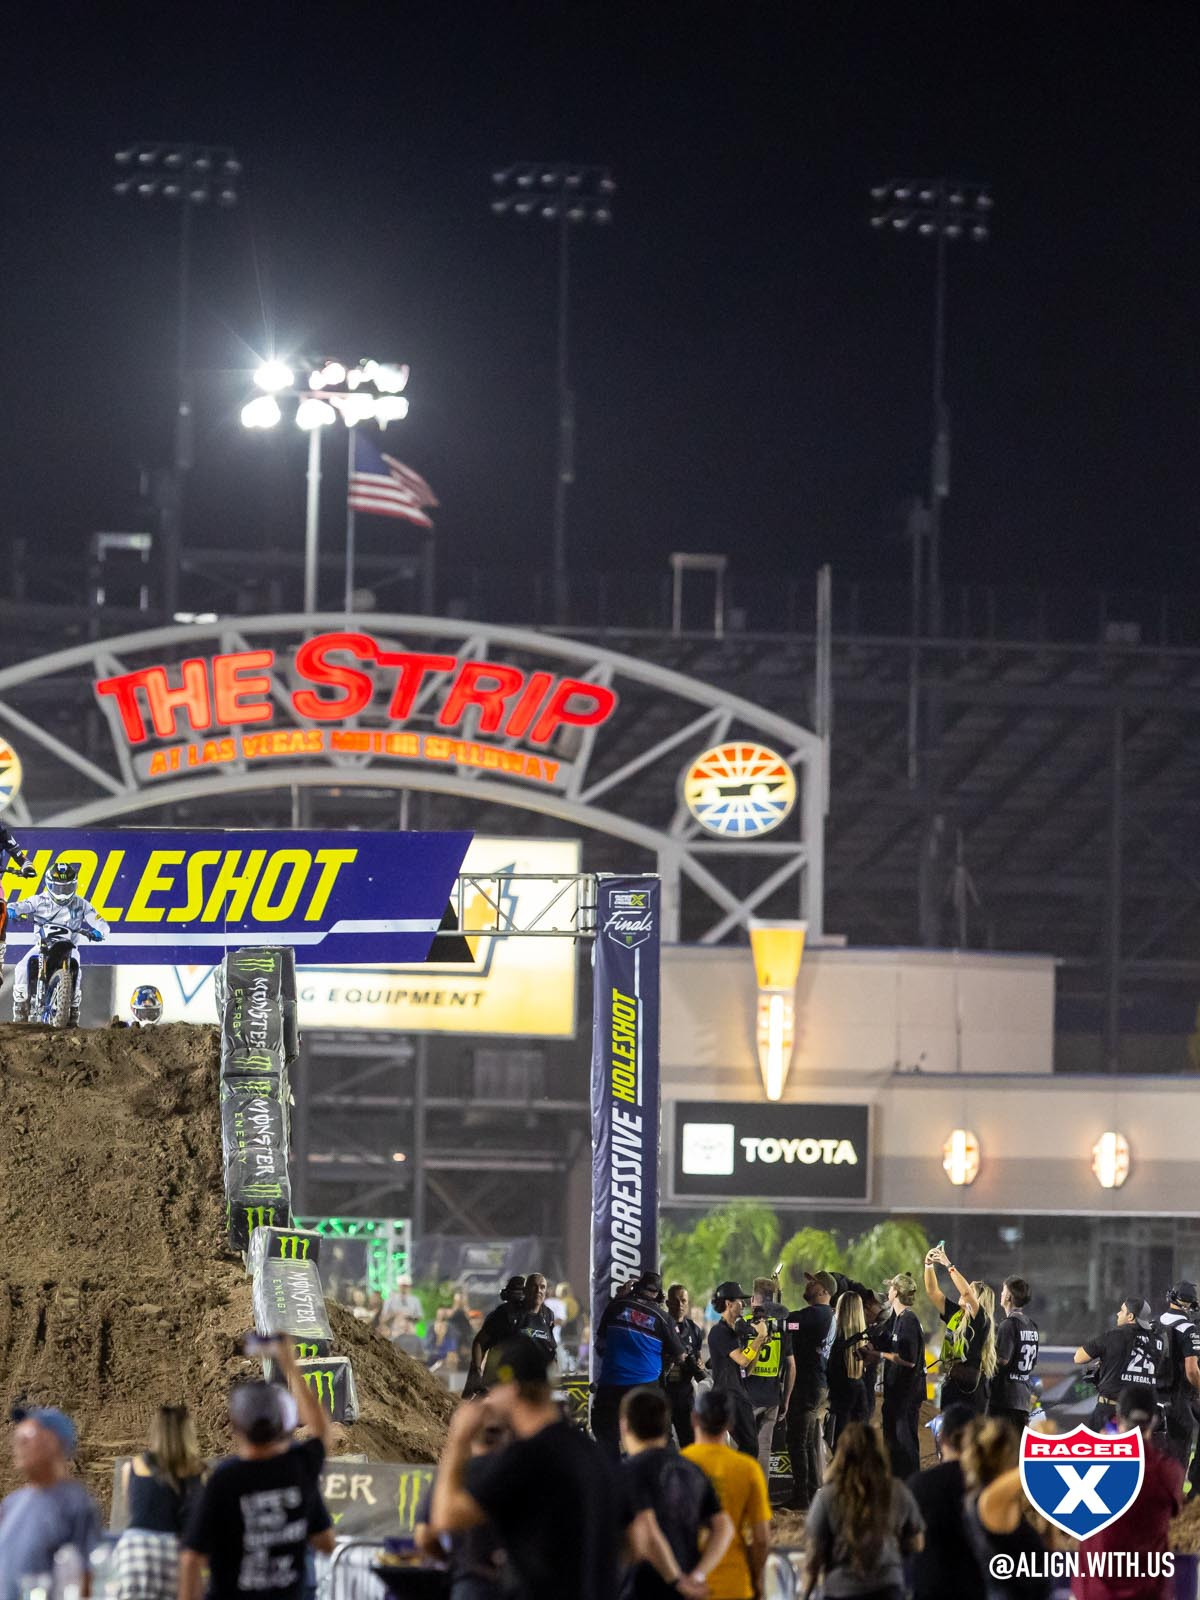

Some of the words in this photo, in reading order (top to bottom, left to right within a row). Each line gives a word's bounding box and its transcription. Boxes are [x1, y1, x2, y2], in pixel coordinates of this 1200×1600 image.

[96, 650, 274, 744] THE
[291, 632, 617, 743] STRIP
[149, 748, 181, 776] AT
[187, 738, 236, 766] LAS
[47, 926, 69, 940] 2
[603, 910, 653, 932] Finals
[328, 987, 487, 1007] EQUIPMENT
[611, 988, 636, 1103] HOLESHOT
[247, 1098, 275, 1176] MONSTER
[739, 1137, 858, 1165] TOYOTA
[287, 1271, 317, 1323] MONSTER
[1121, 1373, 1132, 1382] LAS
